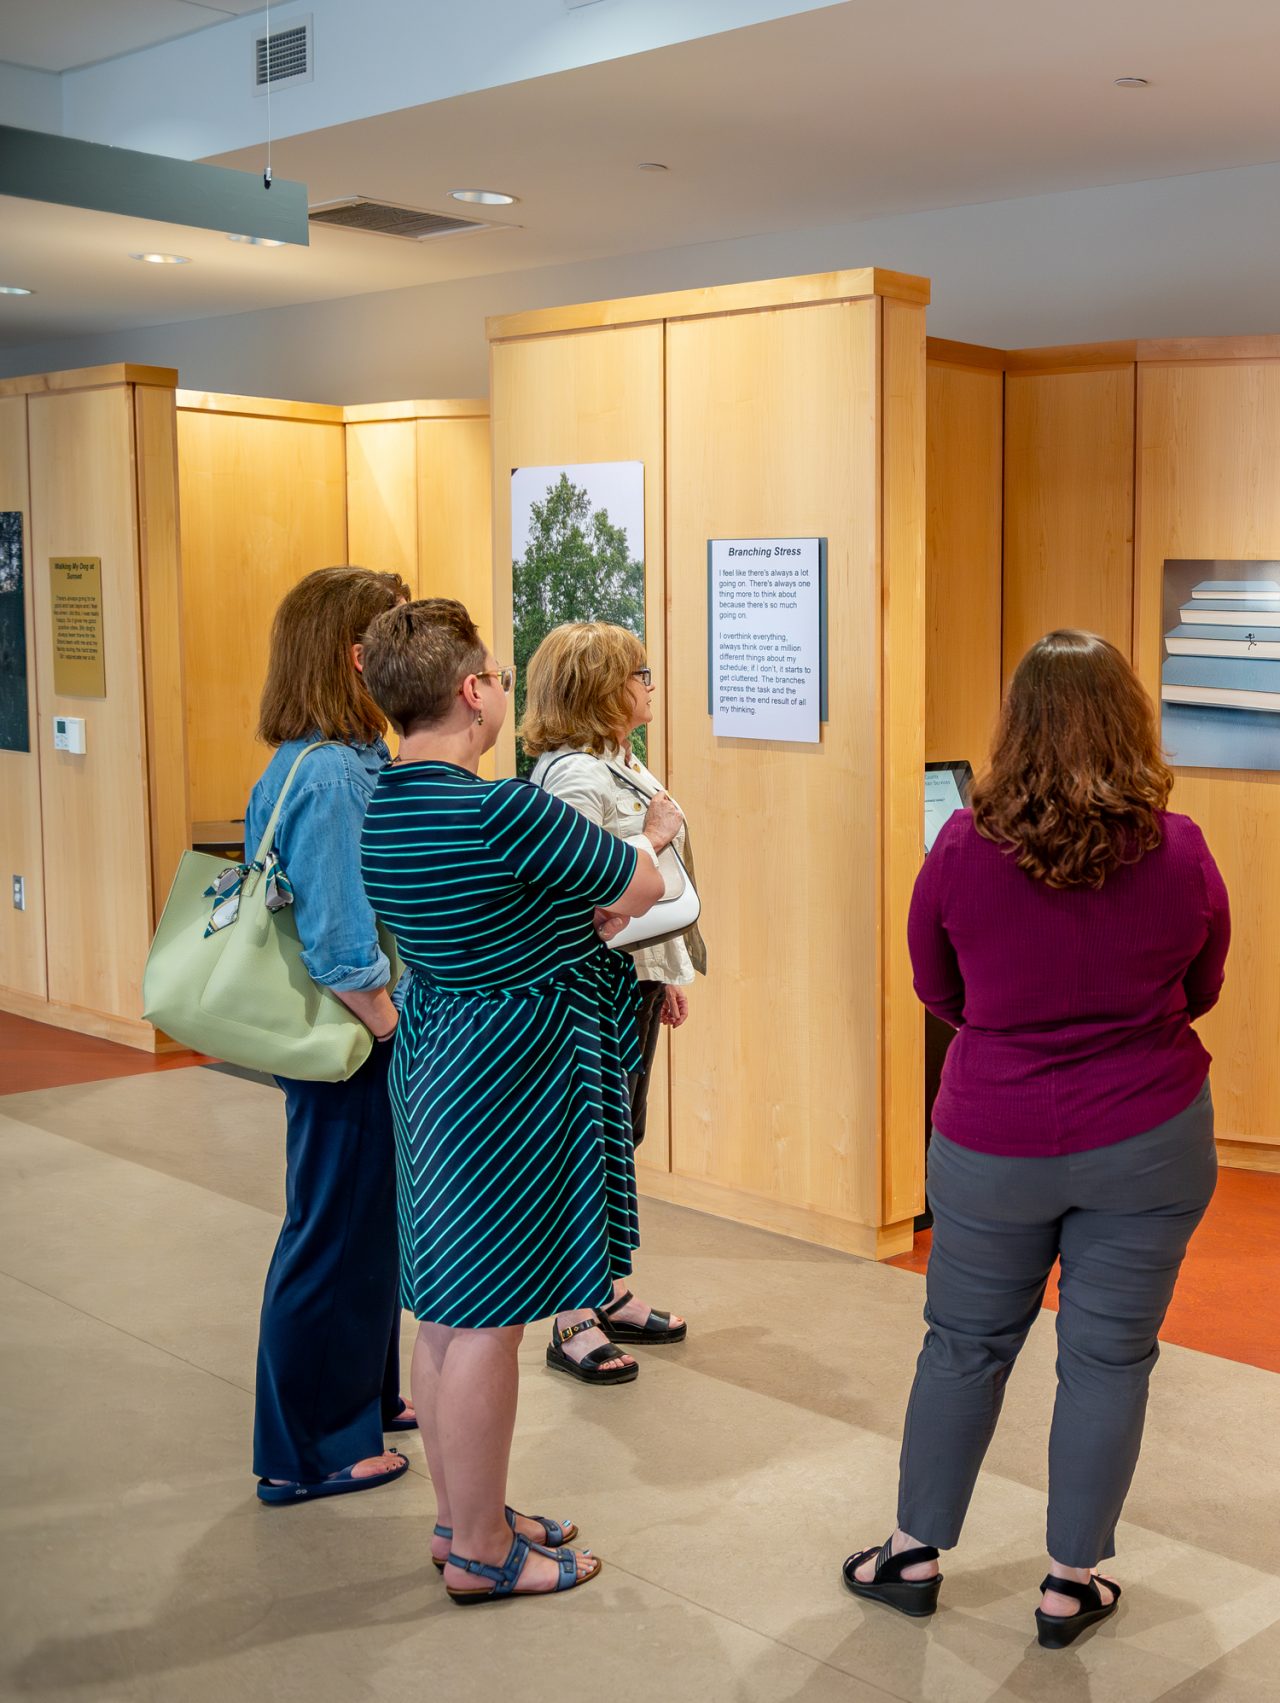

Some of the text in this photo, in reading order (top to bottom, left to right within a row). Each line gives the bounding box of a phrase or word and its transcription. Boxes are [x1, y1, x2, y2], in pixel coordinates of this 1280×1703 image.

[728, 547, 801, 558] Branching Stress
[719, 591, 734, 599] thing
[761, 590, 777, 598] think
[747, 601, 768, 609] there's
[780, 601, 797, 609] much
[723, 632, 751, 640] overthink
[720, 643, 741, 651] always
[781, 644, 802, 652] million
[719, 653, 745, 661] different
[746, 654, 765, 663] things
[767, 654, 785, 662] about
[720, 685, 744, 693] express
[746, 685, 756, 693] the
[786, 687, 798, 695] the
[720, 706, 730, 714] my
